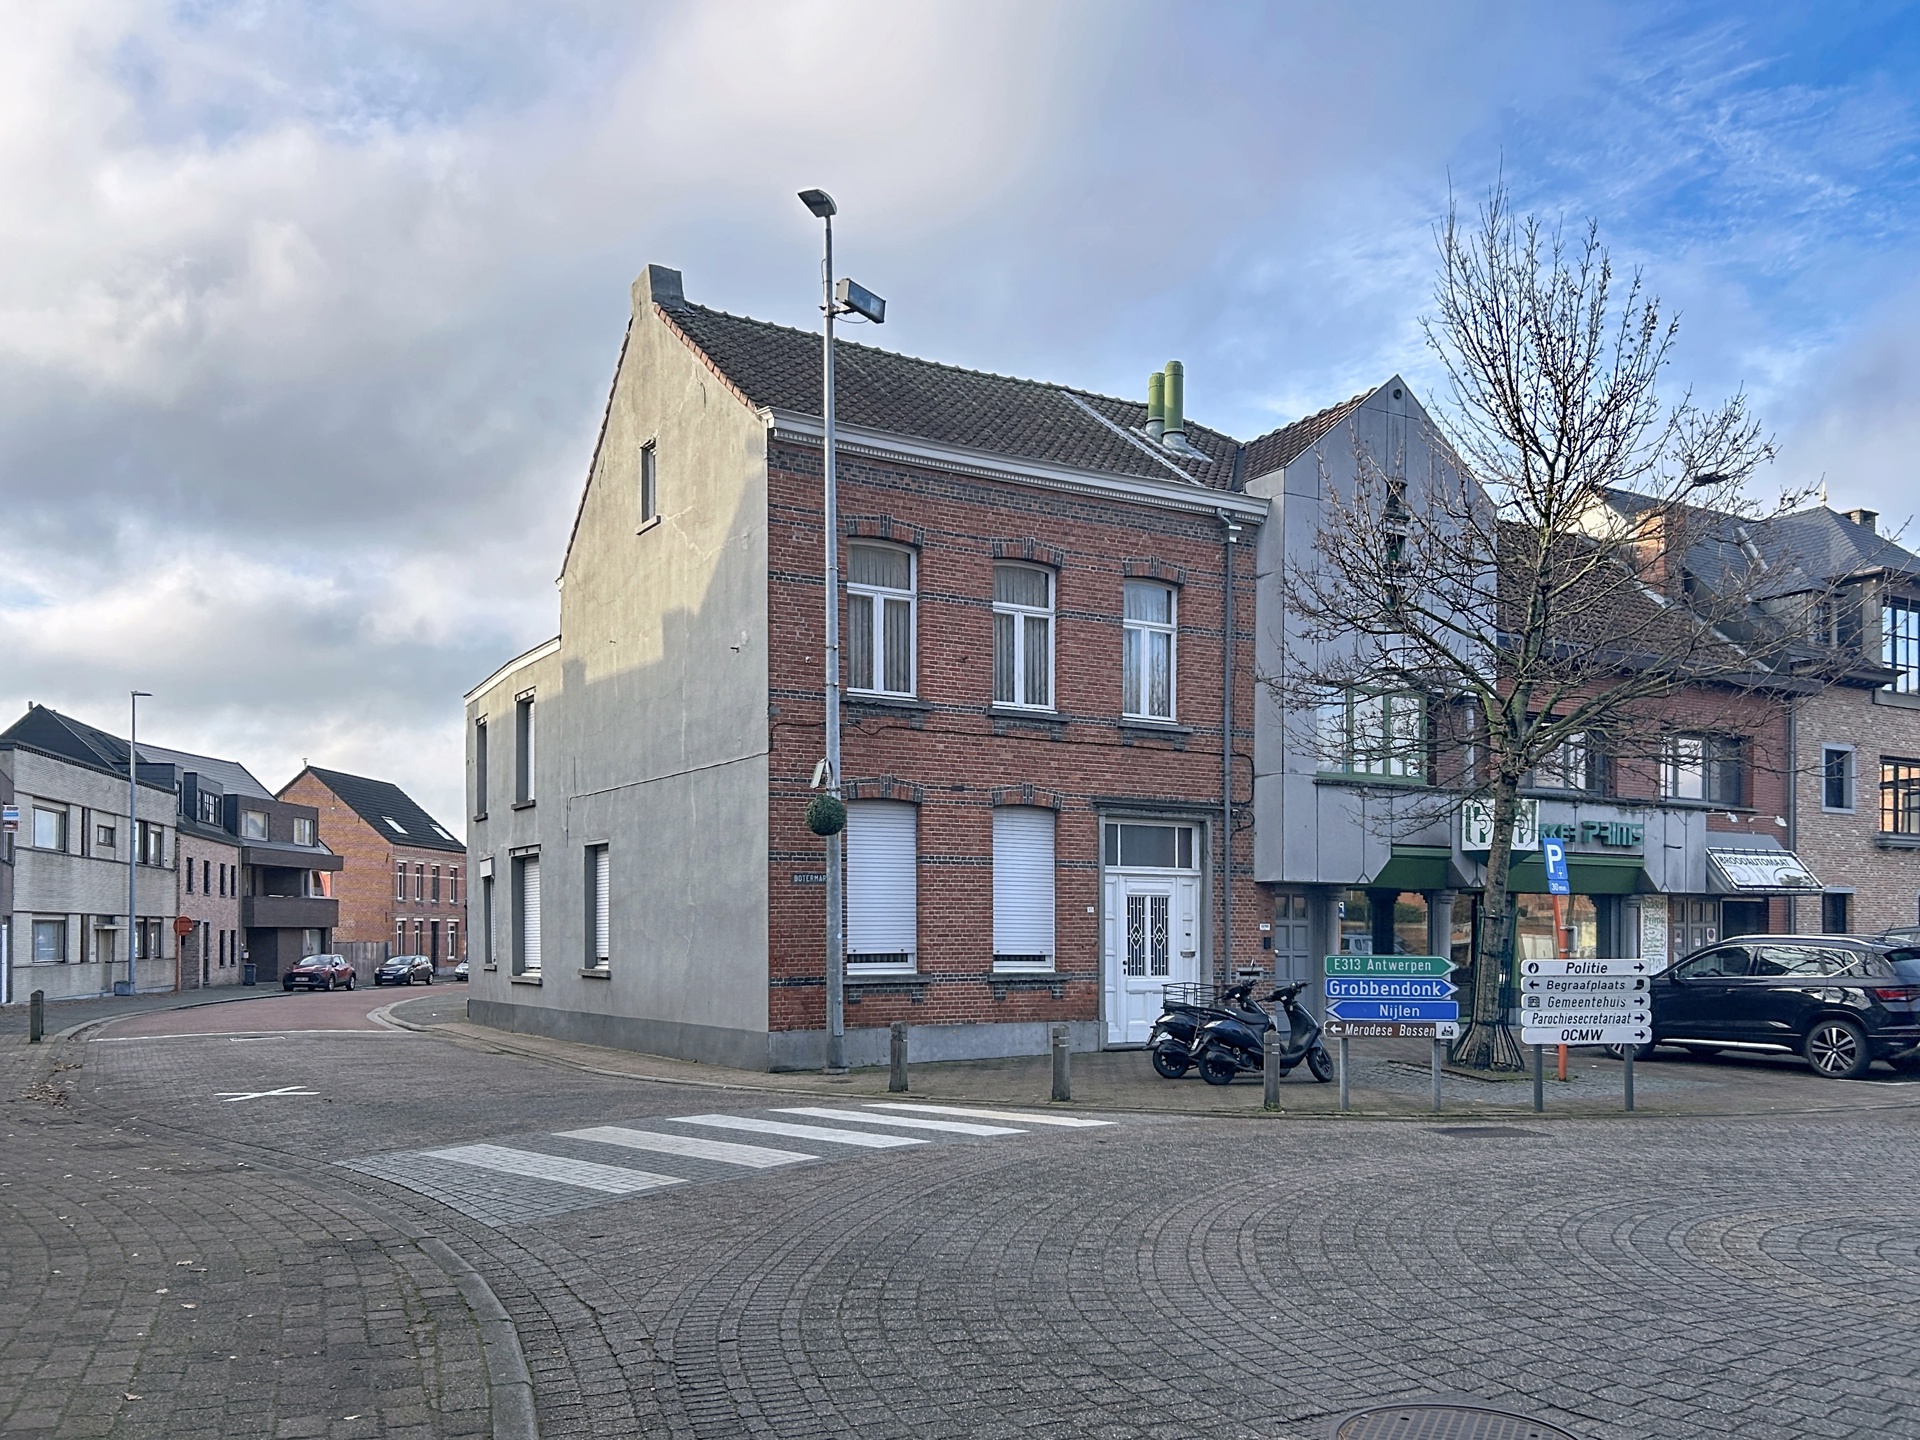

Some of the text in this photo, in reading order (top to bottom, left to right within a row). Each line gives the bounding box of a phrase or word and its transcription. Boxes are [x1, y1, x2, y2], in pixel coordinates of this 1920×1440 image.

[1546, 844, 1562, 873] P
[1718, 856, 1791, 867] BROODAUTOMAAT
[1551, 882, 1559, 891] 30
[1334, 958, 1431, 973] E313 Antwerpen
[1565, 962, 1608, 974] Politie
[1329, 980, 1441, 996] Grobbendonk
[1546, 980, 1626, 992] Begraafplaats
[1547, 996, 1626, 1008] Gemeentehuis
[1379, 1004, 1420, 1019] Nijlen
[1532, 1012, 1632, 1025] Parochiesecretariaat
[1344, 1023, 1435, 1037] Merodese Bossen
[1561, 1029, 1604, 1041] OCMW
